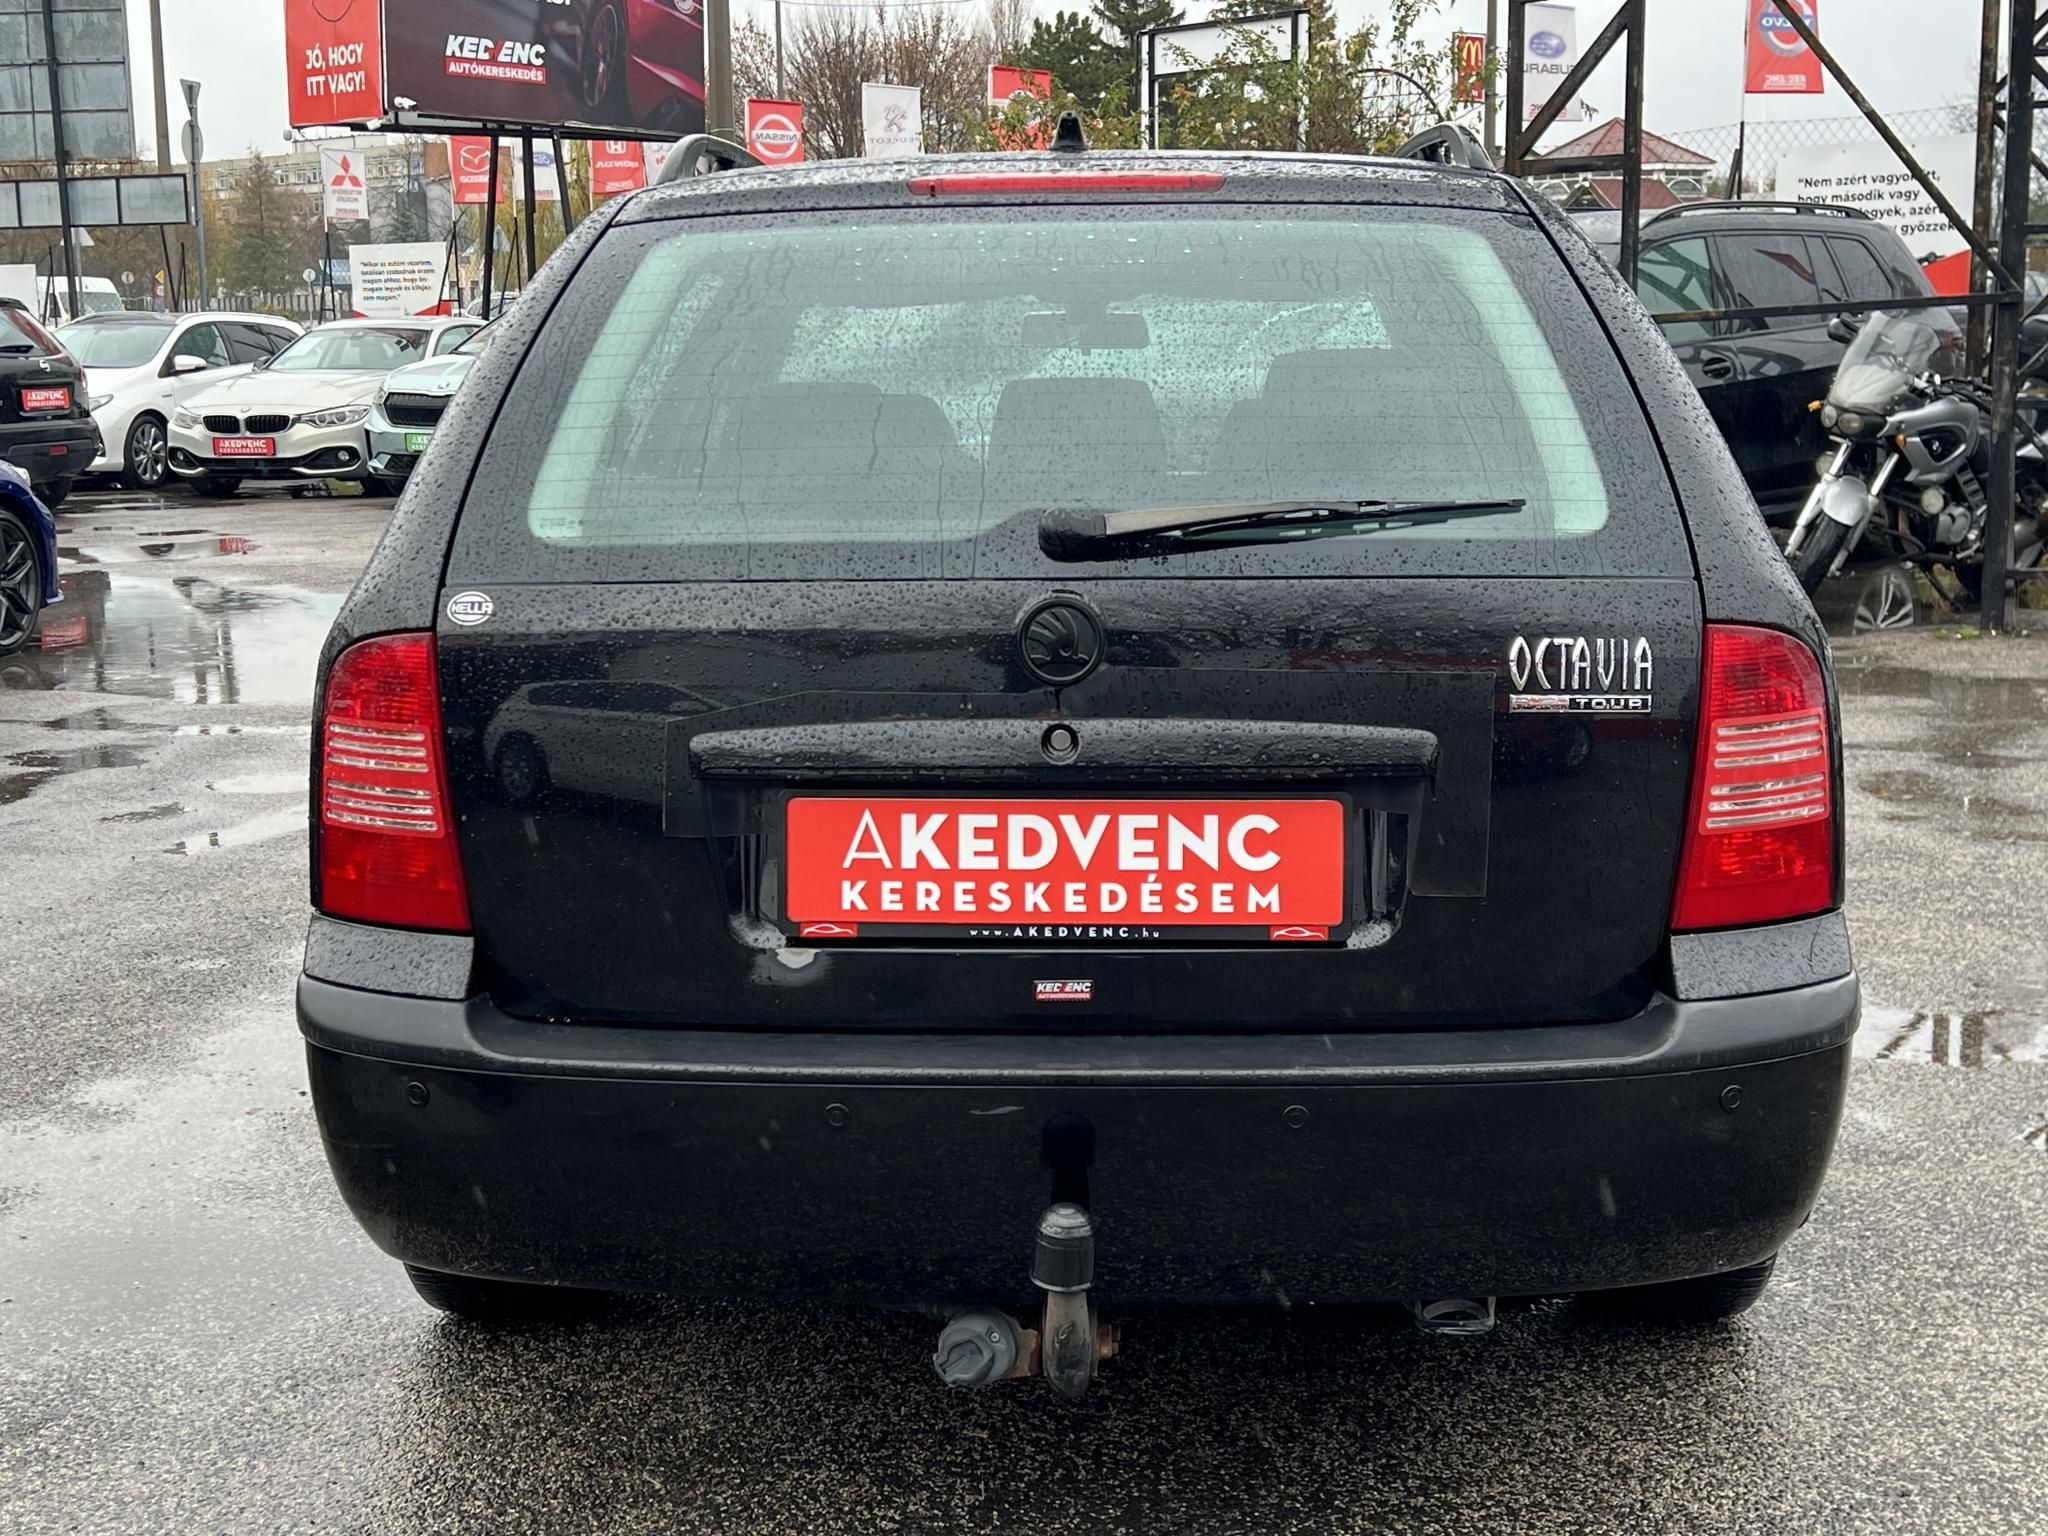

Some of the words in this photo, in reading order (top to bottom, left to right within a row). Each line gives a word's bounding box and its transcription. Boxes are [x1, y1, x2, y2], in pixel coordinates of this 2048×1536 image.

[305, 43, 326, 71] JÓ,
[329, 42, 364, 66] HOGY
[448, 61, 543, 81] AUTÓKERESKEDÉS
[306, 75, 326, 96] ITT
[327, 70, 366, 94] VAGY!
[1836, 173, 1868, 186] azért
[1831, 189, 1884, 203] második
[1889, 190, 1920, 202] vagy
[1909, 203, 1940, 216] azér
[451, 602, 494, 615] HELLA
[1509, 636, 1652, 691] OCTAVIA
[1575, 698, 1642, 710] TOUR
[841, 873, 1281, 914] KERESKEDÉSEM
[969, 926, 1160, 938] www.AKEDVENC.hu
